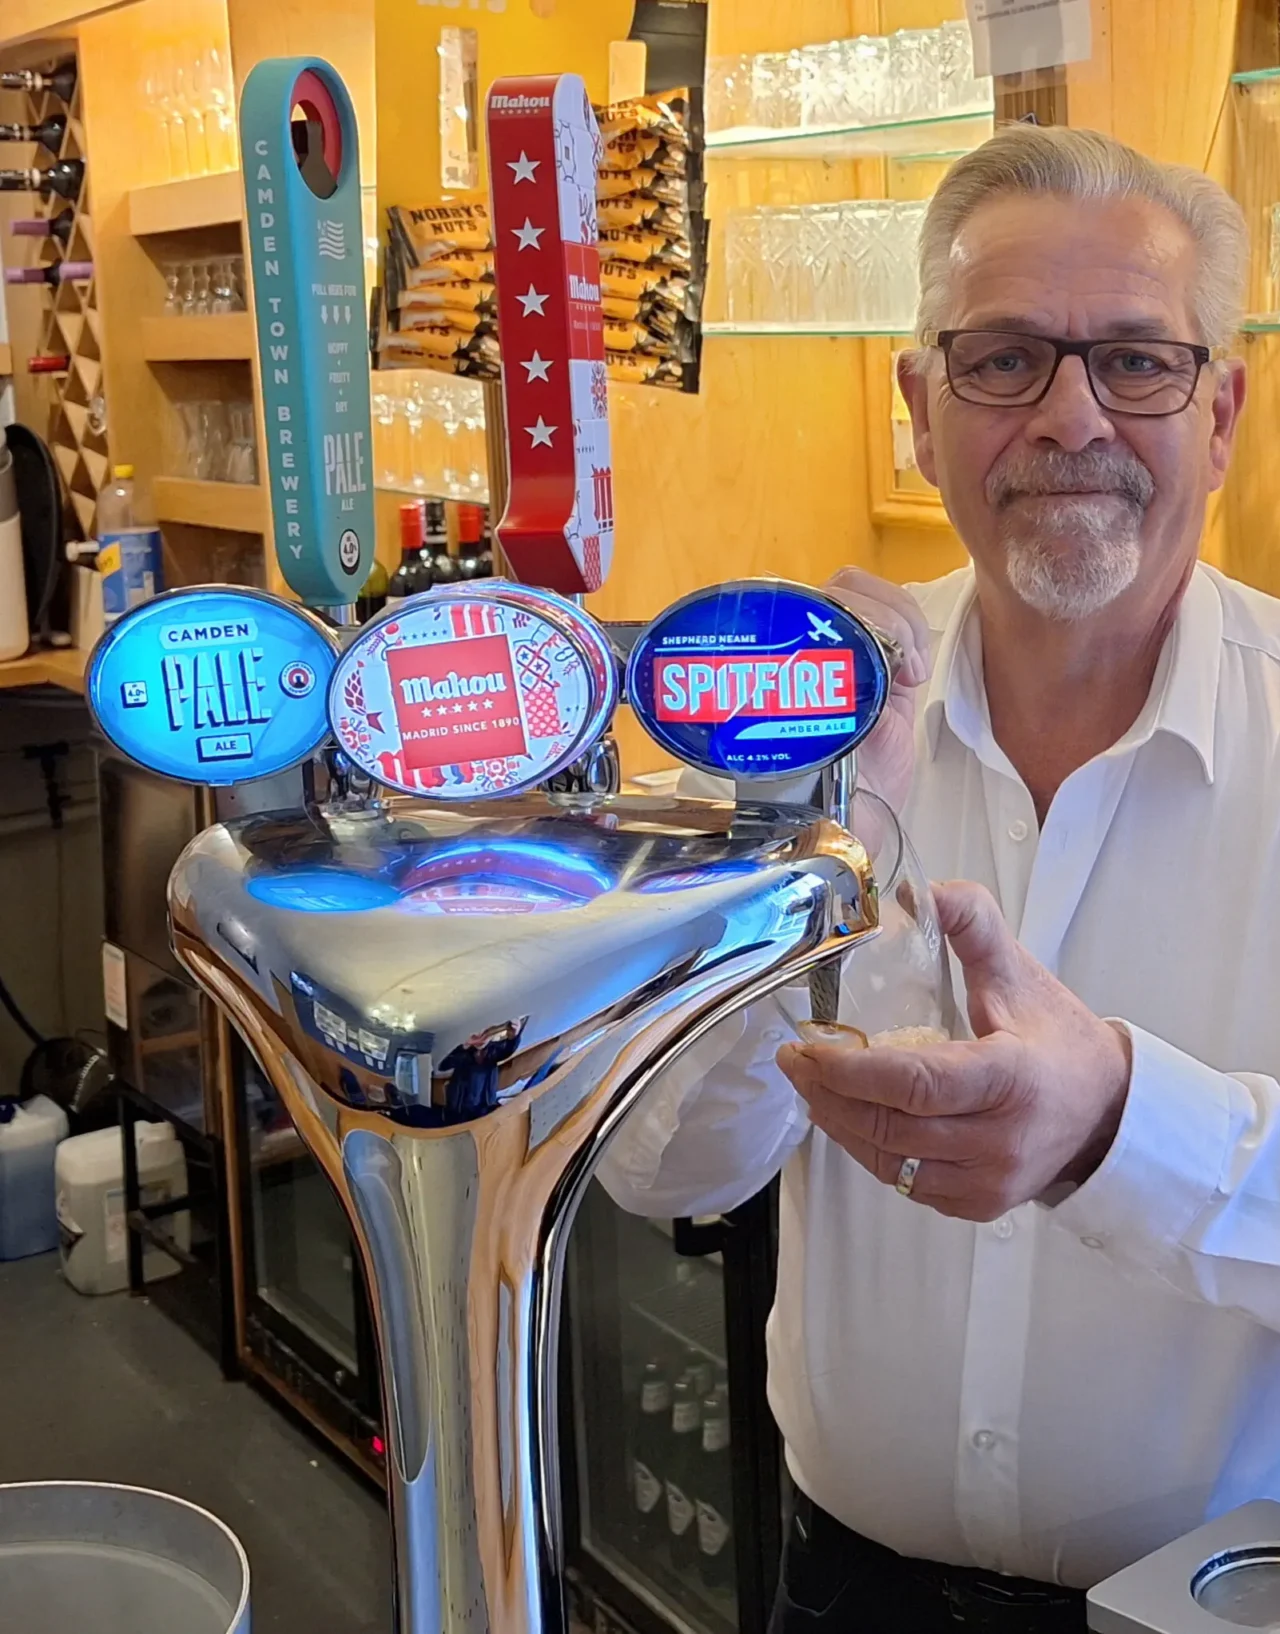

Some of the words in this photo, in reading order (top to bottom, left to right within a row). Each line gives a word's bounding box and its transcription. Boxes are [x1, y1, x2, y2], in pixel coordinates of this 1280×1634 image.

[491, 95, 550, 109] Mahou
[598, 170, 632, 181] UTS
[255, 140, 280, 276] CAMDEN
[431, 220, 478, 235] NUTS
[268, 298, 288, 384] TOWN
[606, 353, 637, 367] UTS
[323, 431, 367, 496] PALE
[277, 406, 302, 560] BREWERY
[168, 623, 249, 643] CAMDEN
[662, 635, 716, 645] SHEPHERD
[718, 634, 757, 644] NEAME
[161, 647, 273, 731] PALE
[400, 671, 507, 704] Mahou
[662, 656, 848, 717] SPITFIRE
[402, 726, 449, 741] MADRID
[453, 721, 488, 734] SINCE
[492, 716, 520, 729] 1890
[780, 724, 820, 734] AMBER
[825, 722, 847, 731] ALE
[215, 740, 237, 751] ALE
[726, 754, 744, 762] ALC
[772, 753, 791, 761] VOL
